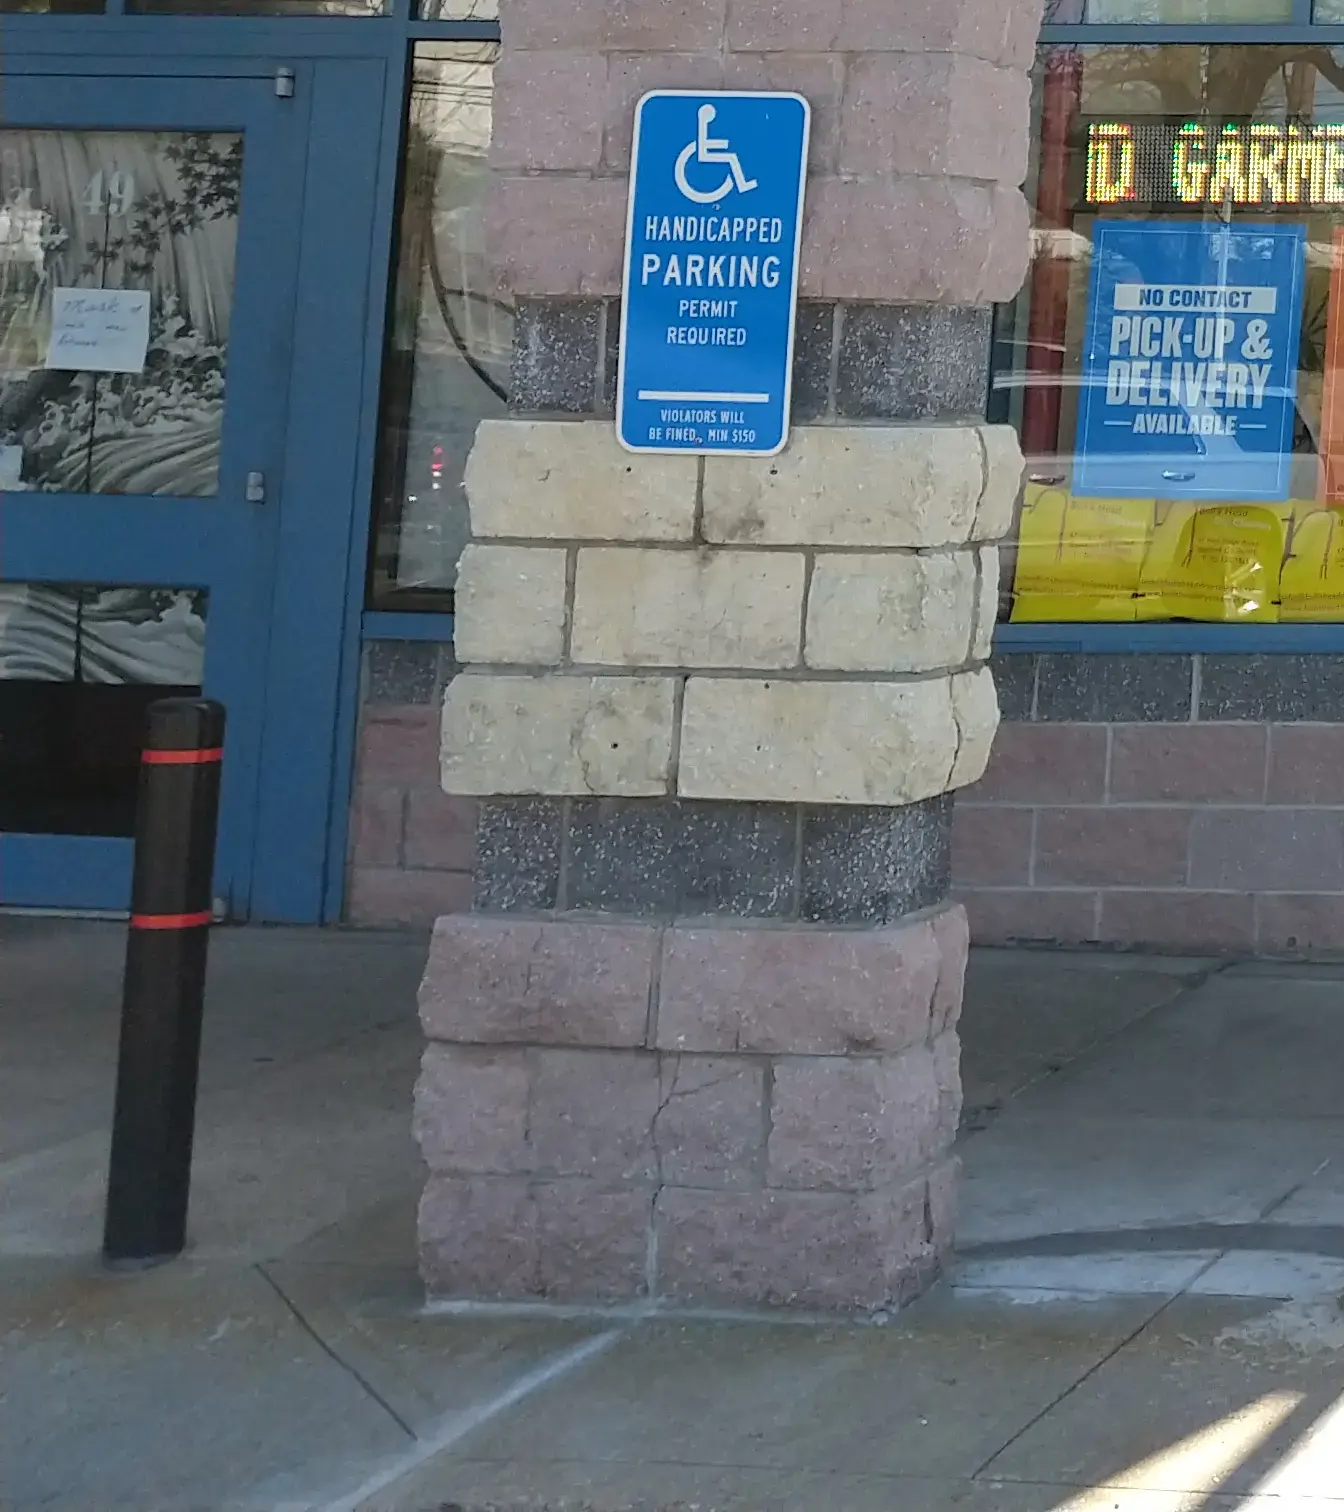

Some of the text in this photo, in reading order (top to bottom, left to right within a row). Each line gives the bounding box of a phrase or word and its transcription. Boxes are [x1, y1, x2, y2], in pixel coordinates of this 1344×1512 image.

[80, 169, 135, 216] 49
[645, 215, 782, 243] HANDICAPPED
[641, 253, 780, 288] PARKING
[679, 299, 738, 318] PERMIT
[1139, 289, 1252, 308] NO CONTACT
[667, 326, 747, 346] REQUIRED
[1109, 315, 1273, 360] PICK-UP &
[1106, 359, 1272, 409] DELIVERY
[660, 409, 745, 424] VIOLATORS WILL
[1132, 413, 1237, 436] AVAILABLE
[648, 427, 662, 440] BE
[708, 429, 729, 442] MIN
[732, 429, 756, 443] $150
